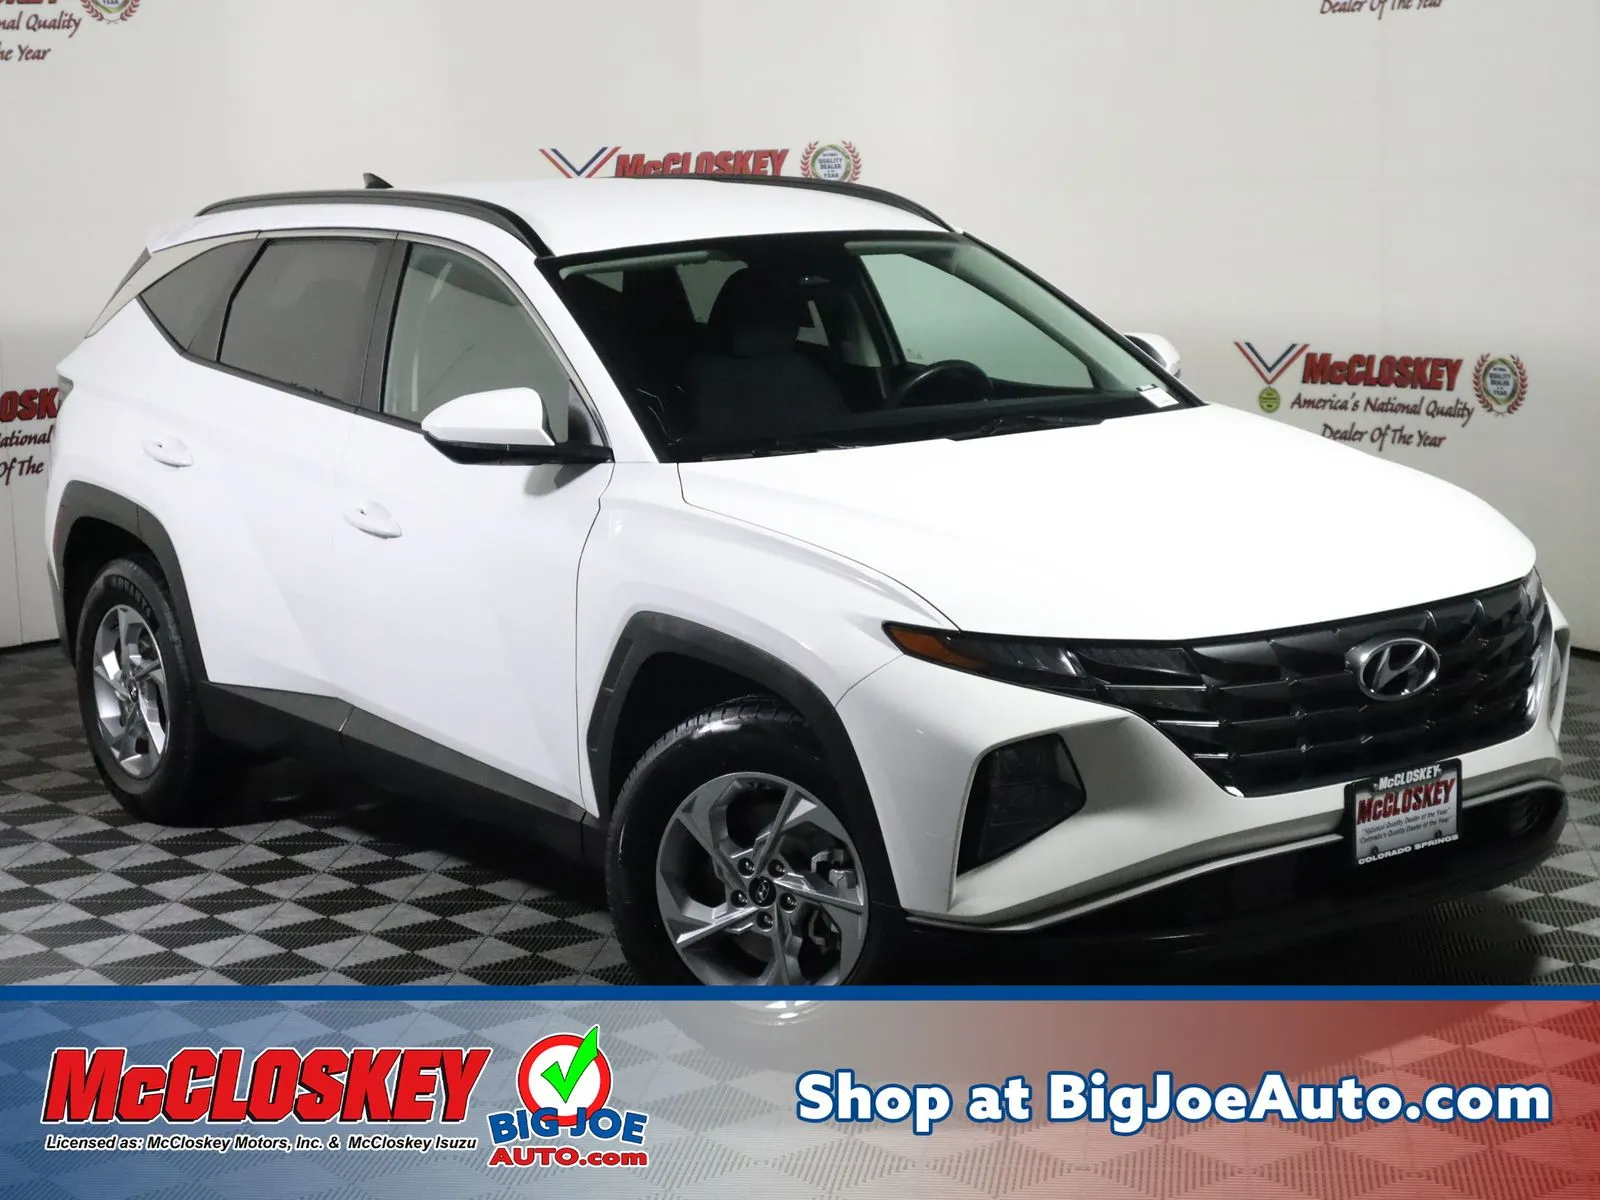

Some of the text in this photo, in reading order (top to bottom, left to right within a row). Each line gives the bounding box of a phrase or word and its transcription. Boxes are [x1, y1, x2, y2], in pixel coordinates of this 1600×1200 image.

[26, 10, 82, 38] Quality
[17, 44, 52, 61] Year
[1302, 352, 1463, 391] McCLOSKEY
[1290, 392, 1360, 412] America's
[1364, 395, 1425, 417] National
[1425, 398, 1475, 427] Quality
[0, 424, 54, 448] ational
[1321, 422, 1447, 452] Dealer Of The Year
[18, 455, 44, 476] The
[1379, 764, 1440, 790] McCLOSKEY
[1356, 778, 1456, 825] McCLOSKEY
[1358, 834, 1459, 865] COLORADO SPRINGS
